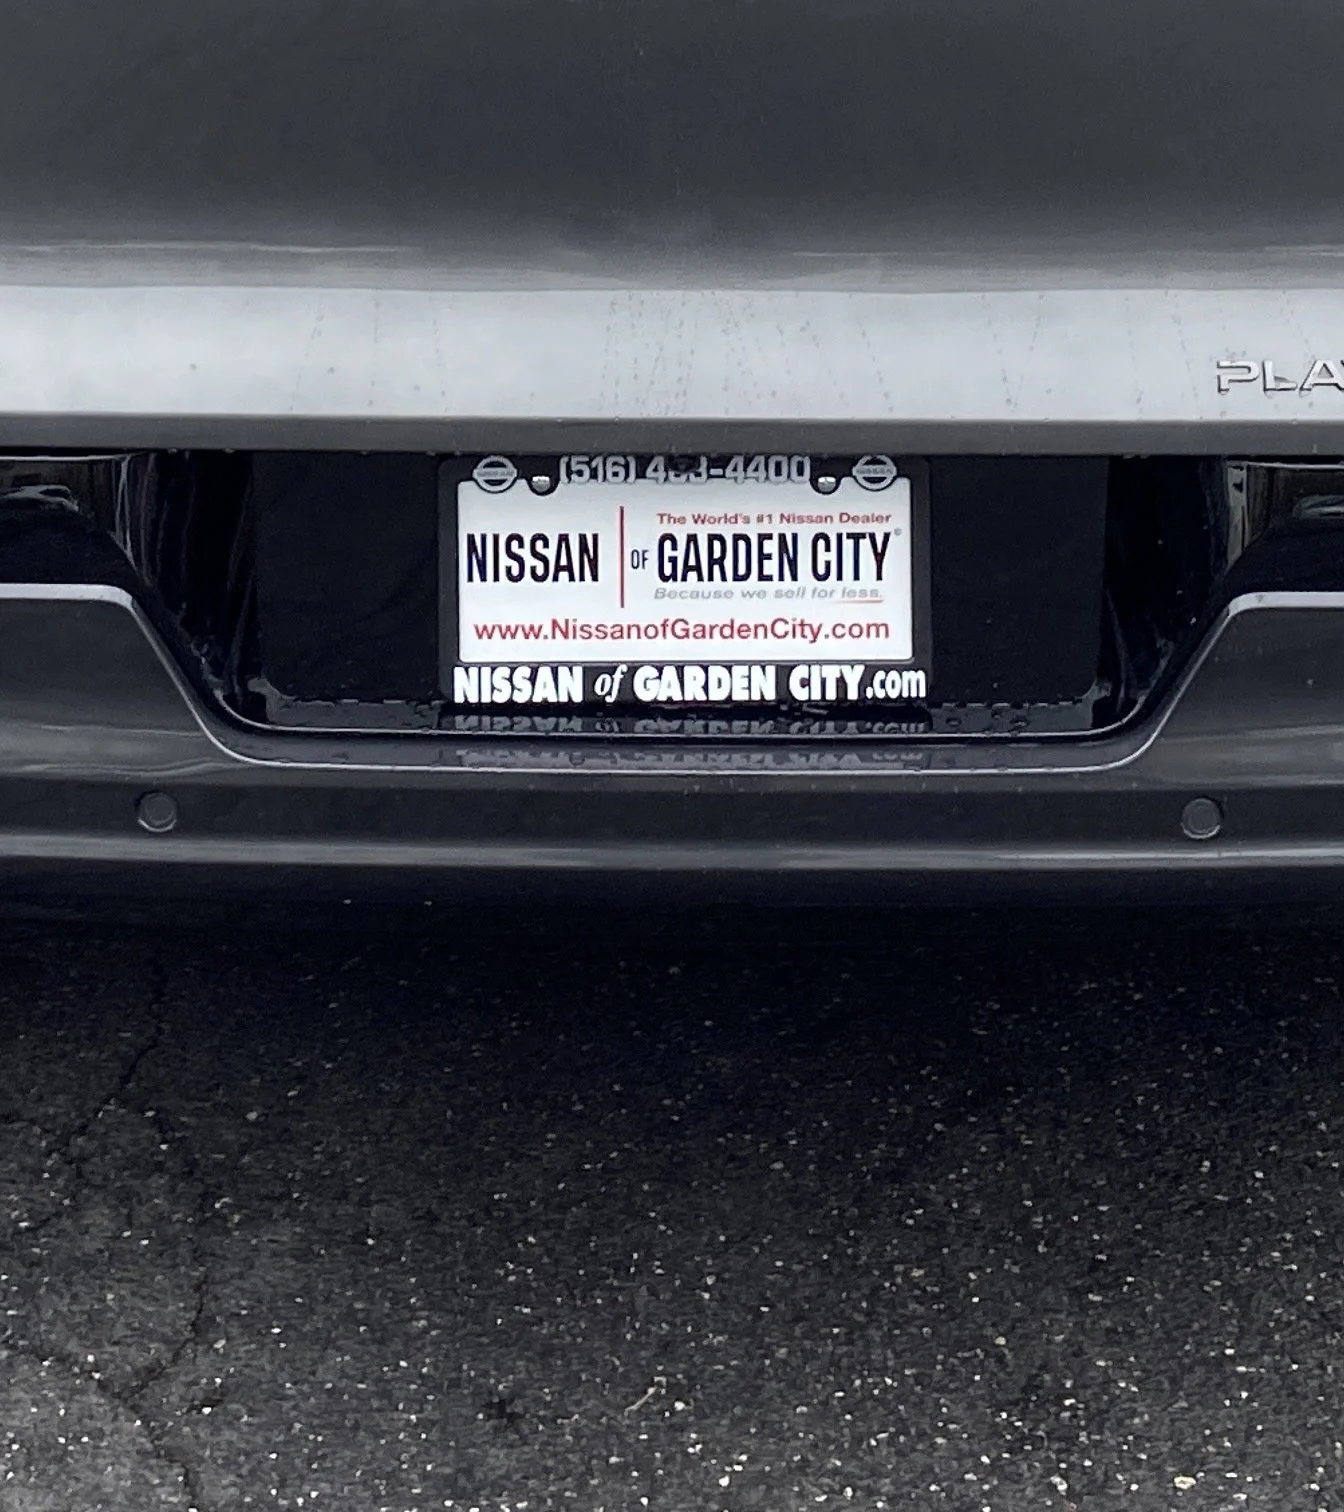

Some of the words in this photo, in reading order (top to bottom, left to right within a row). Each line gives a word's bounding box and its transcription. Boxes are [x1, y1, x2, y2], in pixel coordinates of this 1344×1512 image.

[559, 455, 636, 484] (516)
[657, 512, 687, 525] The
[692, 512, 750, 525] World's
[756, 512, 773, 525] #1
[779, 512, 834, 525] Nissan
[839, 512, 892, 525] Dealer
[466, 533, 599, 582] NISSAN
[630, 549, 649, 569] OF
[657, 532, 799, 582] GARDEN
[811, 532, 892, 581] CITY
[654, 588, 734, 600] Because
[741, 591, 767, 600] we
[774, 588, 807, 600] sell
[811, 588, 836, 600] for
[841, 587, 883, 599] less.
[474, 618, 890, 643] www.NissanofGardenCity.com
[453, 666, 583, 704] NISSAN
[594, 665, 624, 703] of
[633, 665, 777, 702] GARDEN
[788, 664, 927, 701] CITY.com
